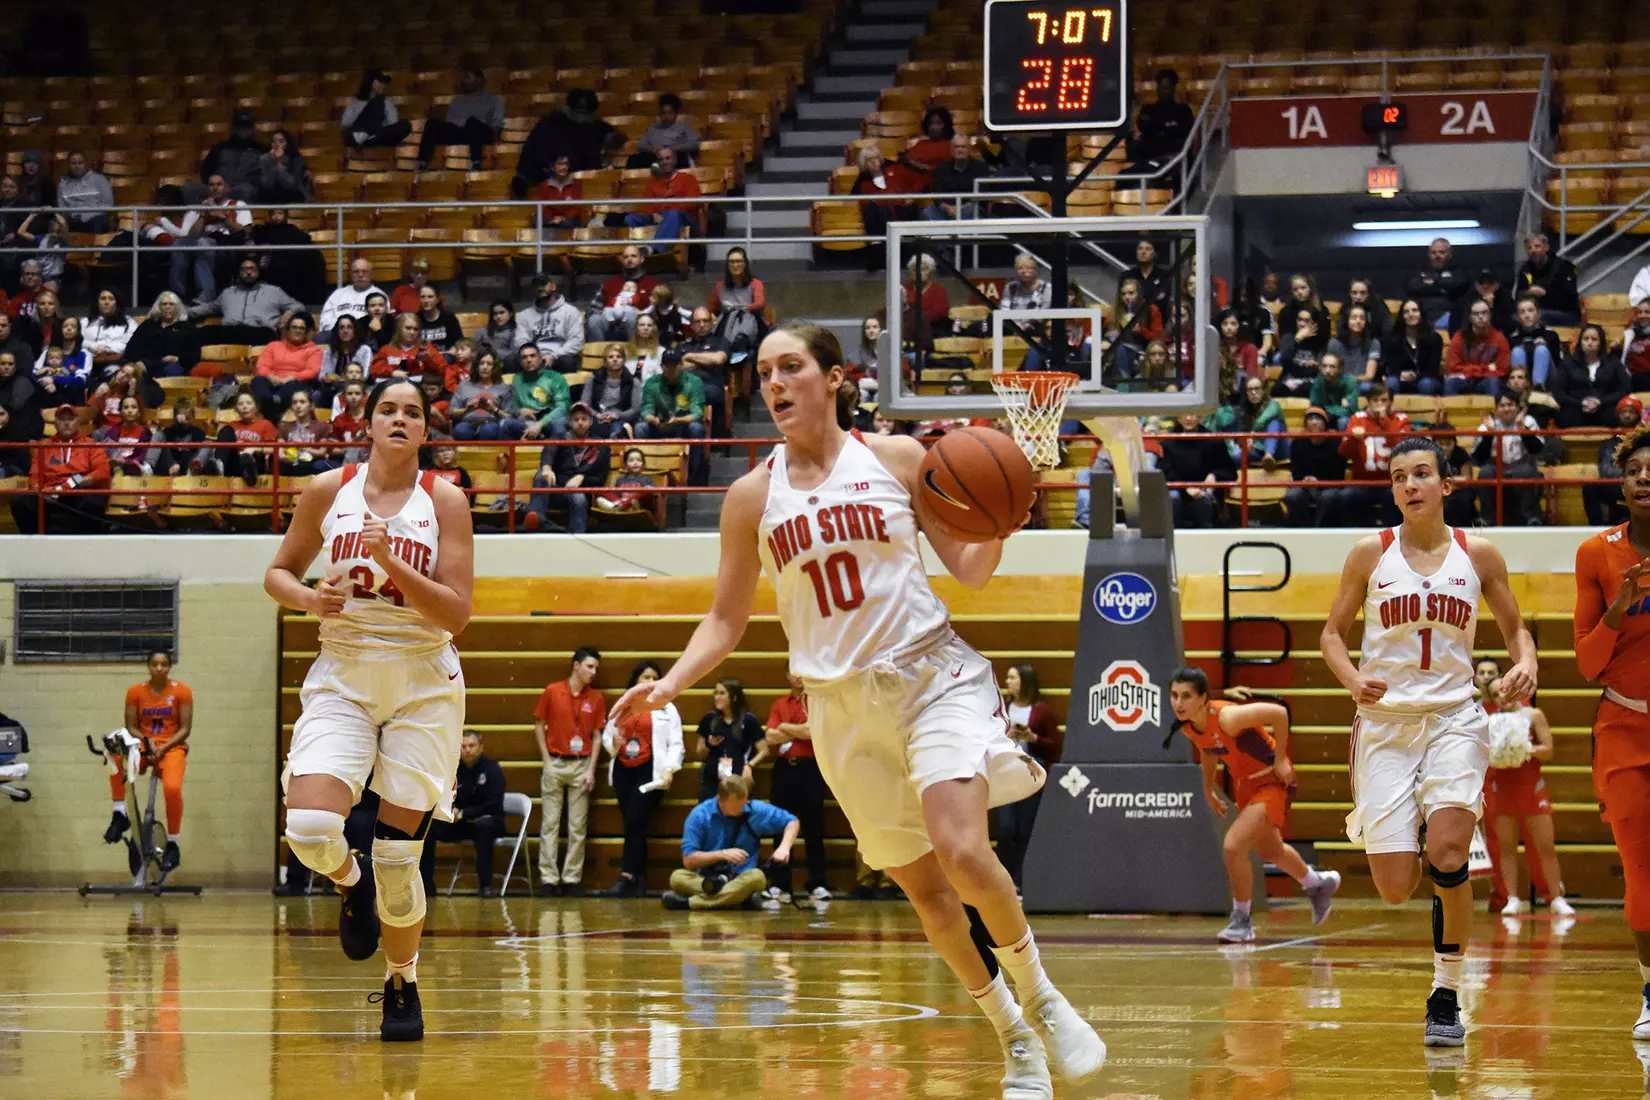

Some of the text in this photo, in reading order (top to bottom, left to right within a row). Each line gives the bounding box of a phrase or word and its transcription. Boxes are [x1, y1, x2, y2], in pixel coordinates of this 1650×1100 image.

[1027, 9, 1111, 45] 7:07
[1017, 58, 1092, 110] 28
[1281, 105, 1328, 139] 1A
[1440, 101, 1496, 135] 2A
[1364, 436, 1392, 472] 15
[767, 503, 890, 575] OHIO STATE
[349, 565, 405, 607] 24
[800, 550, 865, 619] 10
[1099, 579, 1153, 619] Kroger
[1379, 593, 1473, 632] OHIO STATE
[1417, 627, 1433, 671] 1
[1125, 808, 1193, 819] MID-AMERICA
